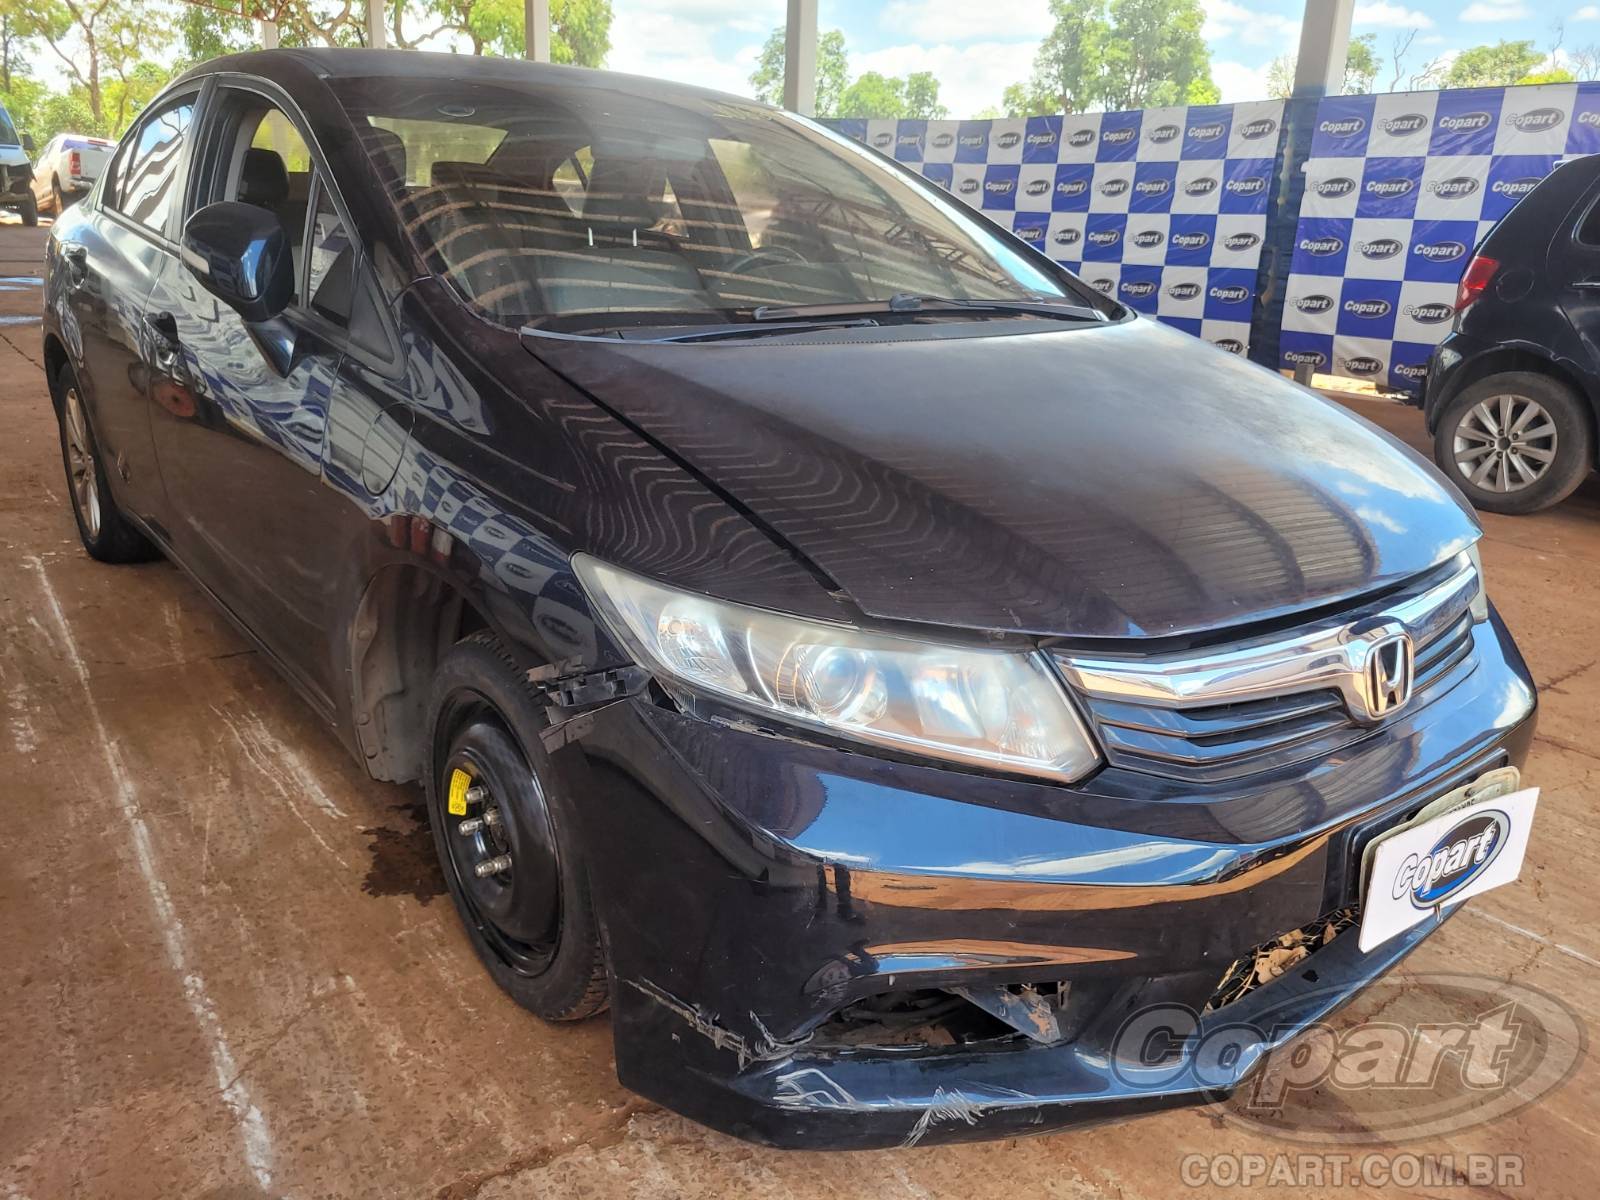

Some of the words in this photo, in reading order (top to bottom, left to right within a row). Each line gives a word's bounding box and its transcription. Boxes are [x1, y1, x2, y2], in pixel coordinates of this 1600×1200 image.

[1320, 119, 1360, 134] Copart
[1377, 117, 1420, 132] Copart
[1439, 115, 1486, 130] Copart
[1505, 112, 1557, 128] Copart
[1027, 133, 1053, 145] Copart
[1065, 132, 1092, 144] opart
[1103, 130, 1132, 143] Copart
[1145, 128, 1174, 142] opart
[1187, 126, 1221, 139] Copart
[960, 135, 983, 146] Copart
[994, 134, 1018, 147] opart
[985, 181, 1012, 193] Copart
[1022, 182, 1047, 194] opart
[1057, 181, 1084, 194] Copart
[1136, 181, 1166, 194] Copart
[1181, 180, 1212, 193] opart
[1226, 179, 1261, 193] Copart
[1311, 180, 1349, 194] Copart
[1366, 180, 1408, 195] Copart
[1427, 180, 1471, 194] Copart
[1492, 180, 1535, 196] Copar
[1051, 231, 1077, 243] opart
[1088, 231, 1117, 244] Copart
[1129, 232, 1160, 245] opart
[1172, 233, 1206, 246] Copart
[1219, 234, 1254, 247] opart
[1300, 238, 1338, 253] Copart
[1353, 240, 1397, 255] Copart
[1413, 243, 1460, 258] Copart
[1121, 282, 1152, 295] Copart
[1163, 285, 1198, 298] opart
[1210, 286, 1245, 300] Copart
[1289, 296, 1328, 309] Copart
[1344, 300, 1386, 314] Copart
[1403, 304, 1448, 319] Copart
[1284, 351, 1321, 365] Copart
[1393, 364, 1428, 377] Copa
[1392, 819, 1498, 900] Copart
